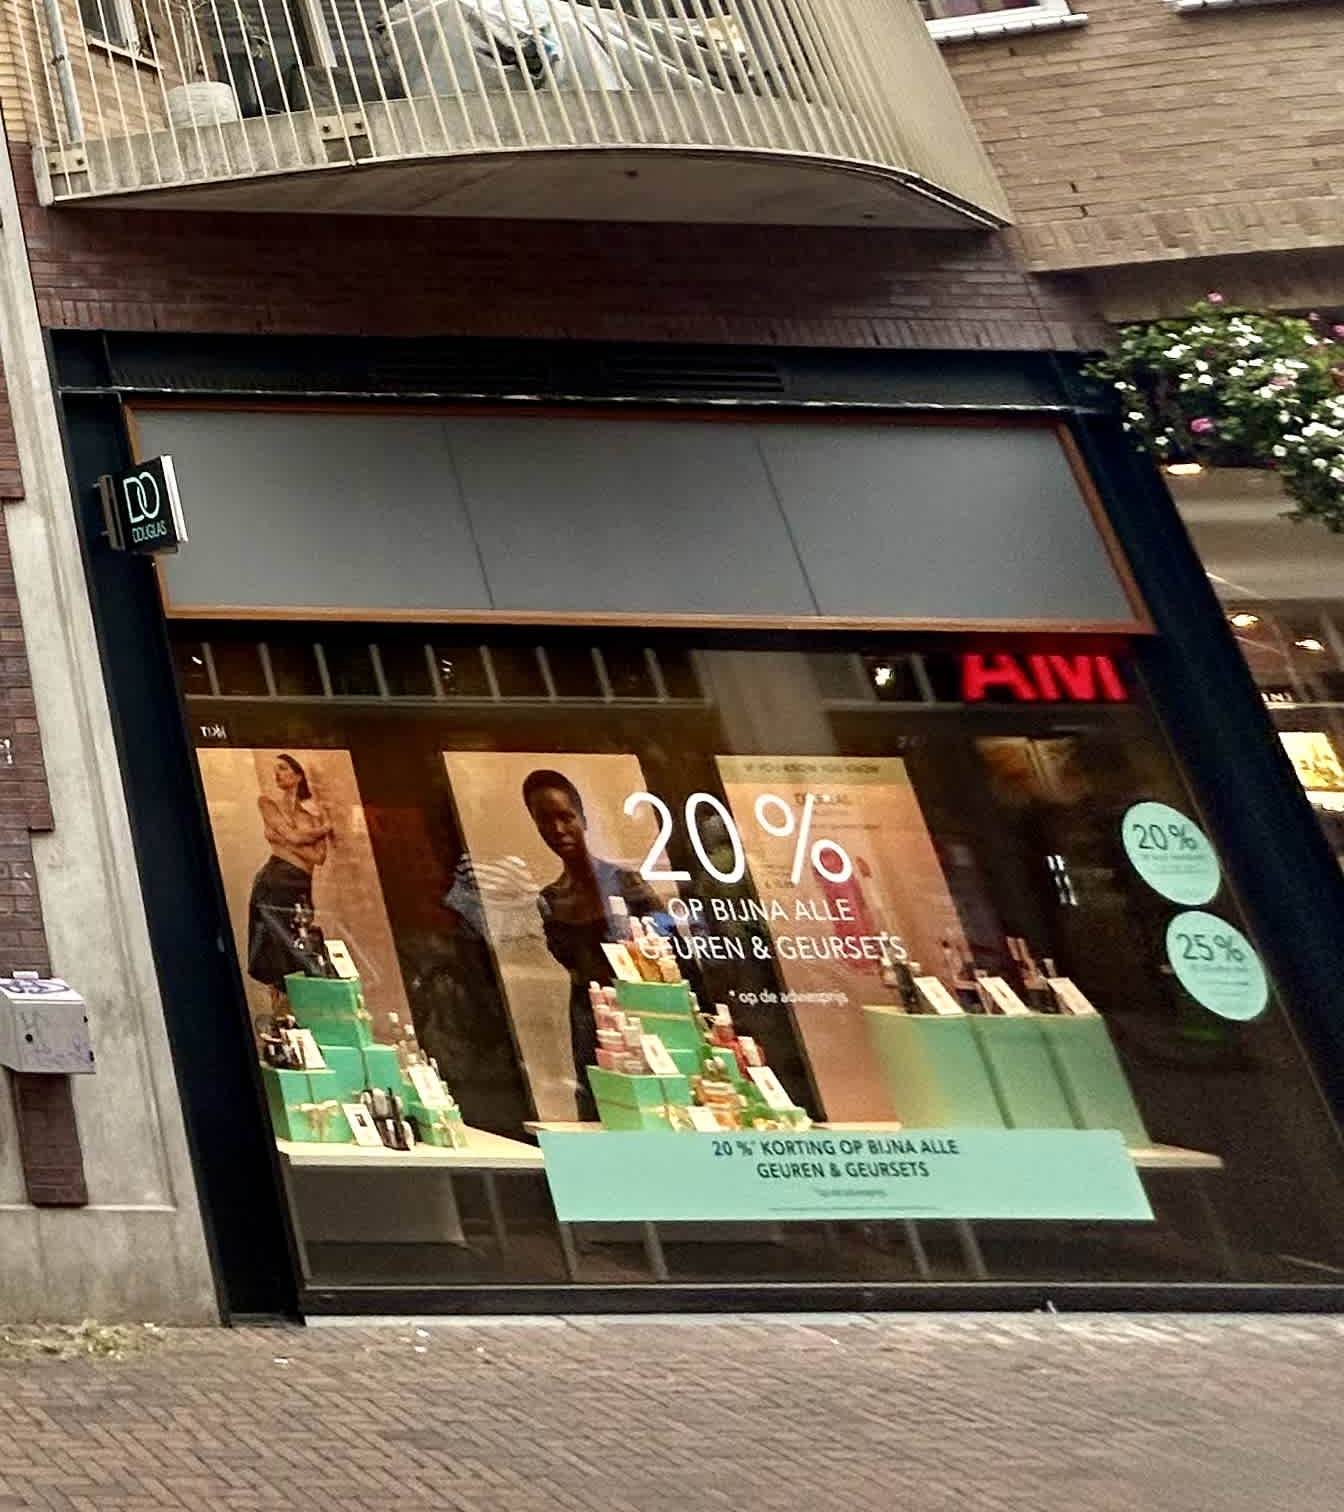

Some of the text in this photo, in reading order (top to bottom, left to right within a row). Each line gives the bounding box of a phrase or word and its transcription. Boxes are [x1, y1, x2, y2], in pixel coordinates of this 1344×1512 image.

[668, 898, 856, 921] OP BIJNA ALLE
[640, 933, 908, 960] GEUREN & GEURSETS
[761, 1139, 836, 1156] KORTING
[839, 1139, 863, 1155] OP
[868, 1139, 915, 1155] BIJNA
[920, 1139, 961, 1155] ALLE
[757, 1160, 931, 1178] GEUREN & GEURSETS
